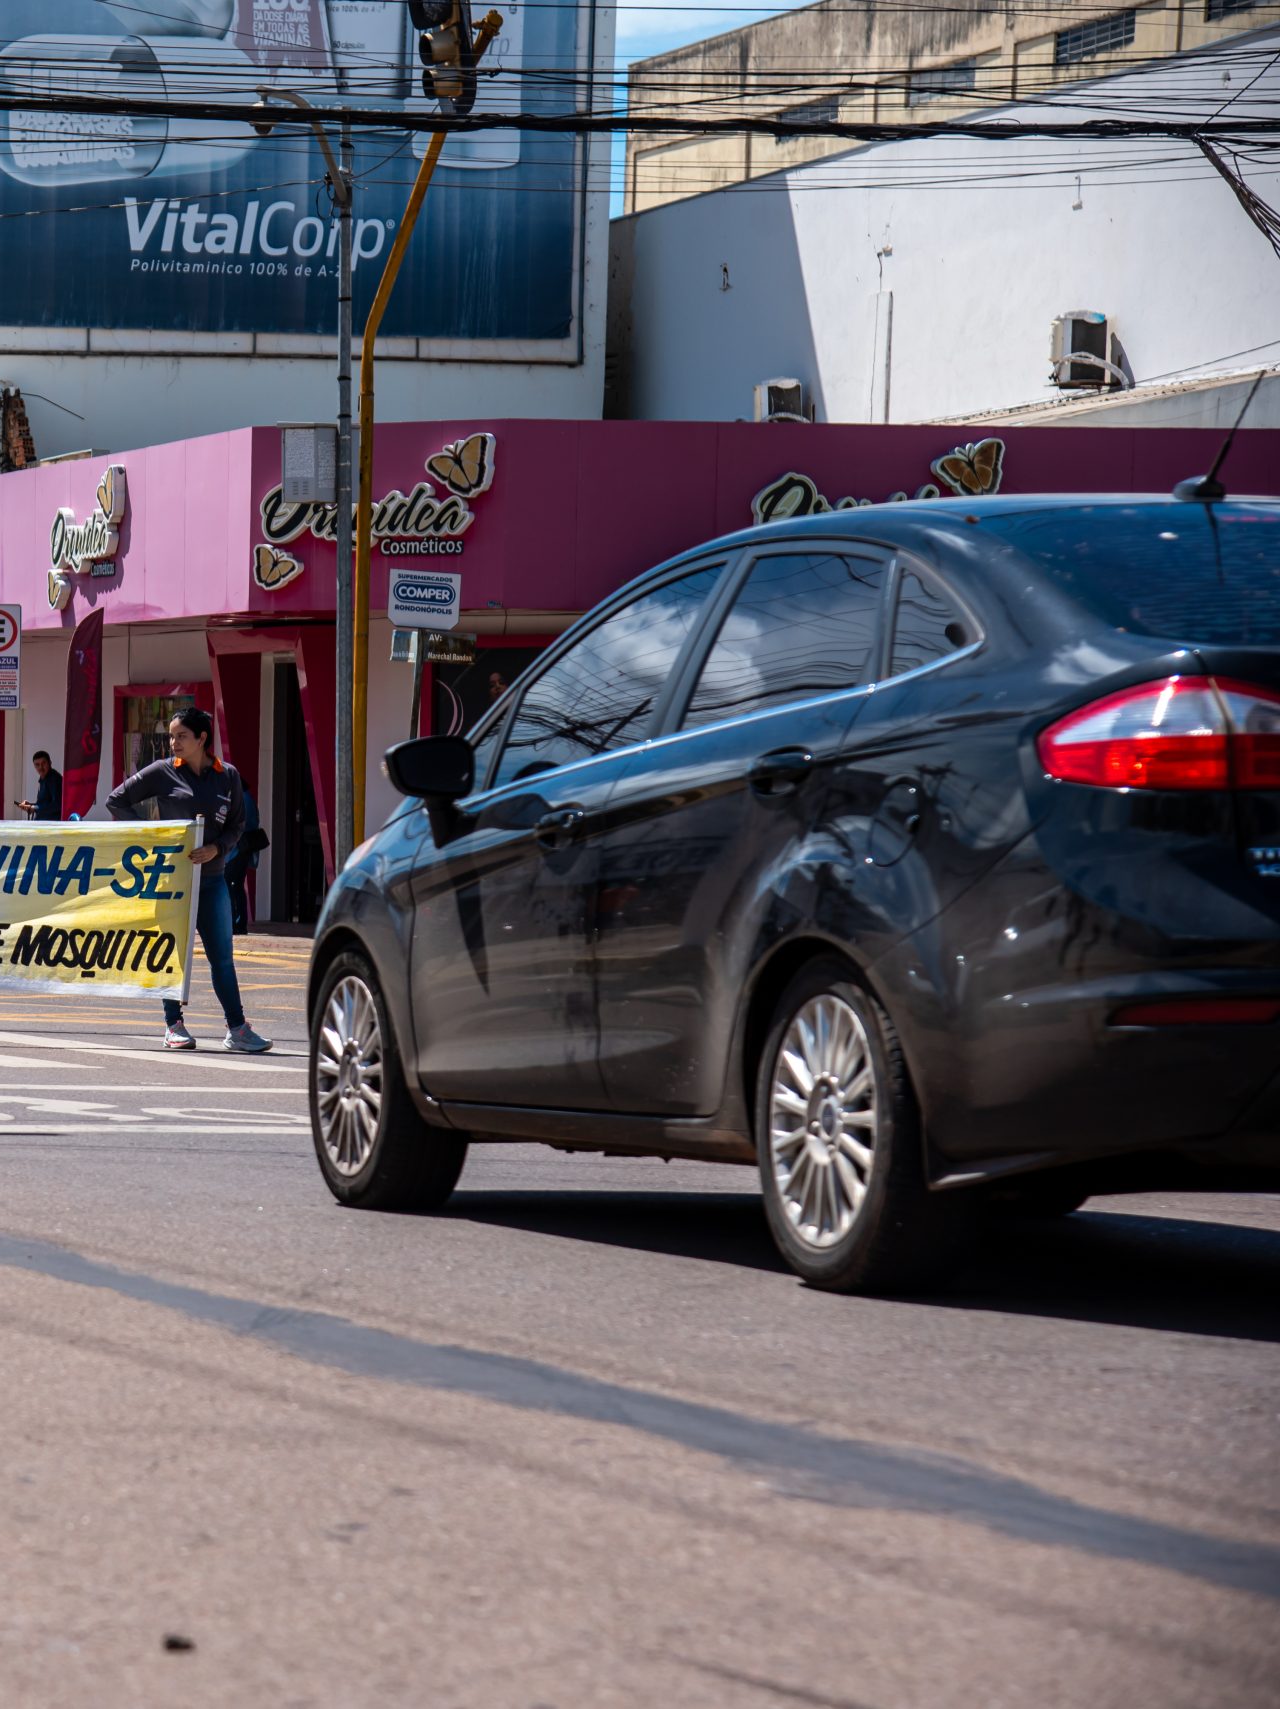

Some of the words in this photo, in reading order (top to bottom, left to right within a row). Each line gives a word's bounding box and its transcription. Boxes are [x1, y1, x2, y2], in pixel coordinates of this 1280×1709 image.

[253, 11, 263, 21] DA
[264, 11, 284, 22] DOSE
[253, 21, 265, 32] EM
[267, 23, 295, 33] TODAS
[297, 24, 310, 34] AS
[253, 31, 311, 48] VITAMINAS
[250, 263, 288, 276] 100%
[294, 264, 311, 277] de
[381, 538, 463, 554] Cosméticos
[398, 574, 453, 583] SUPERMERCADOS
[399, 586, 450, 600] COMPER
[395, 604, 452, 615] RONDONÓPOLIS
[10, 925, 176, 978] MOSQUITO.
